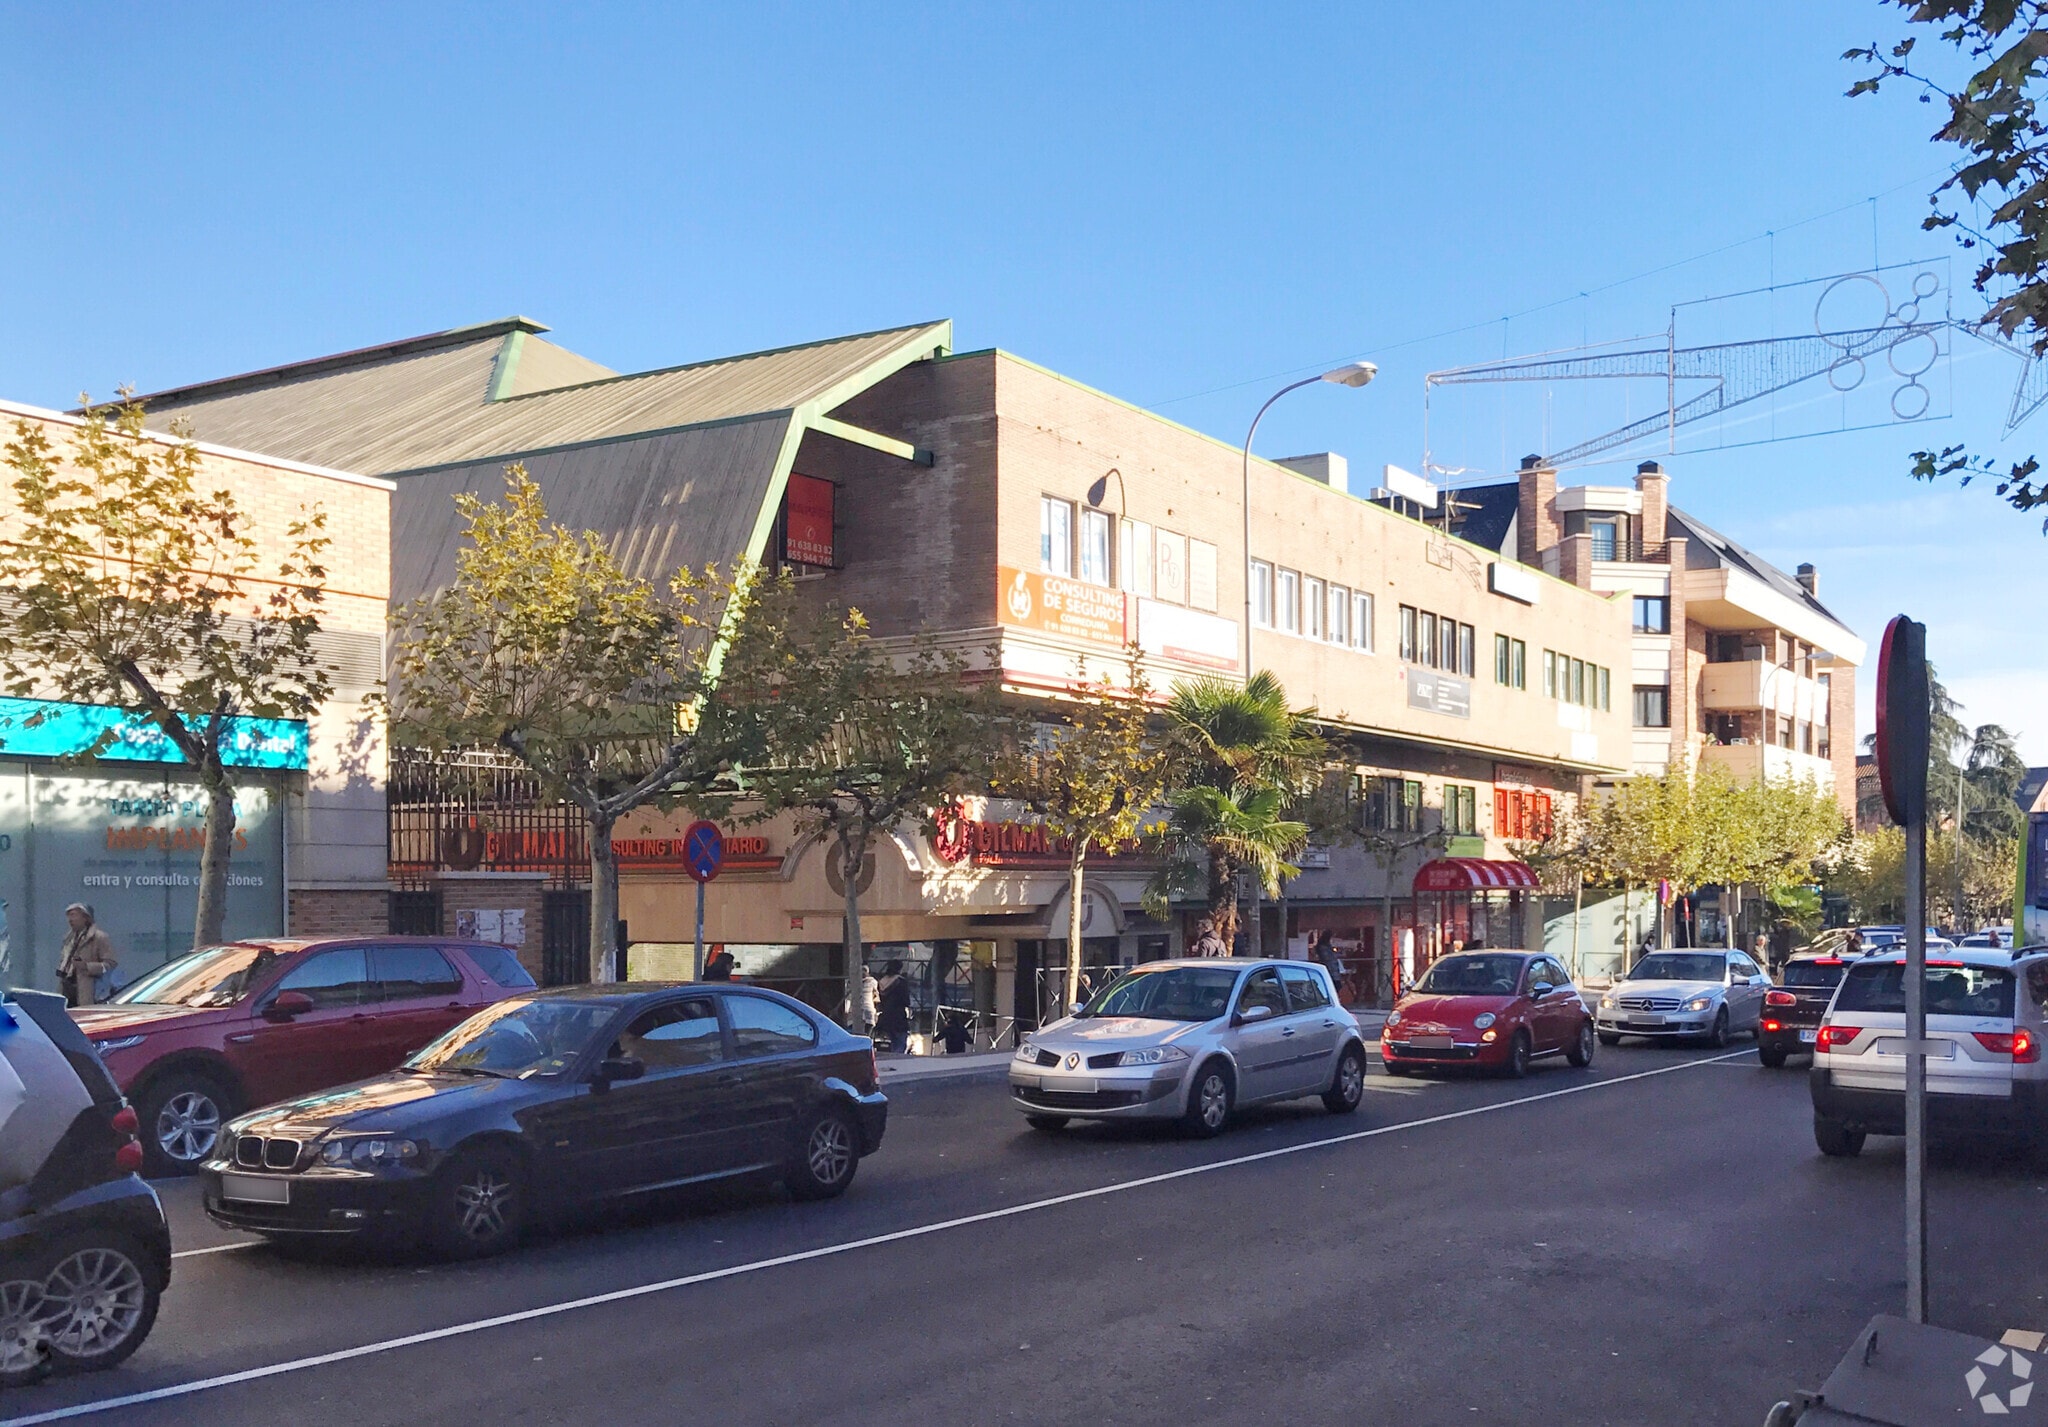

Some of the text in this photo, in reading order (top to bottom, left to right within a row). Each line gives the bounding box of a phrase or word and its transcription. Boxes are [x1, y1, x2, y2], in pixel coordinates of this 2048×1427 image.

[1043, 577, 1123, 609] CONSULTING
[1043, 593, 1123, 624] DE SEGUROS
[111, 799, 243, 818] TARIFA PLA
[107, 826, 247, 851] IMPLANS
[486, 831, 768, 861] GMA SULTING INIARIO
[83, 873, 263, 888] entra y consulta cciones
